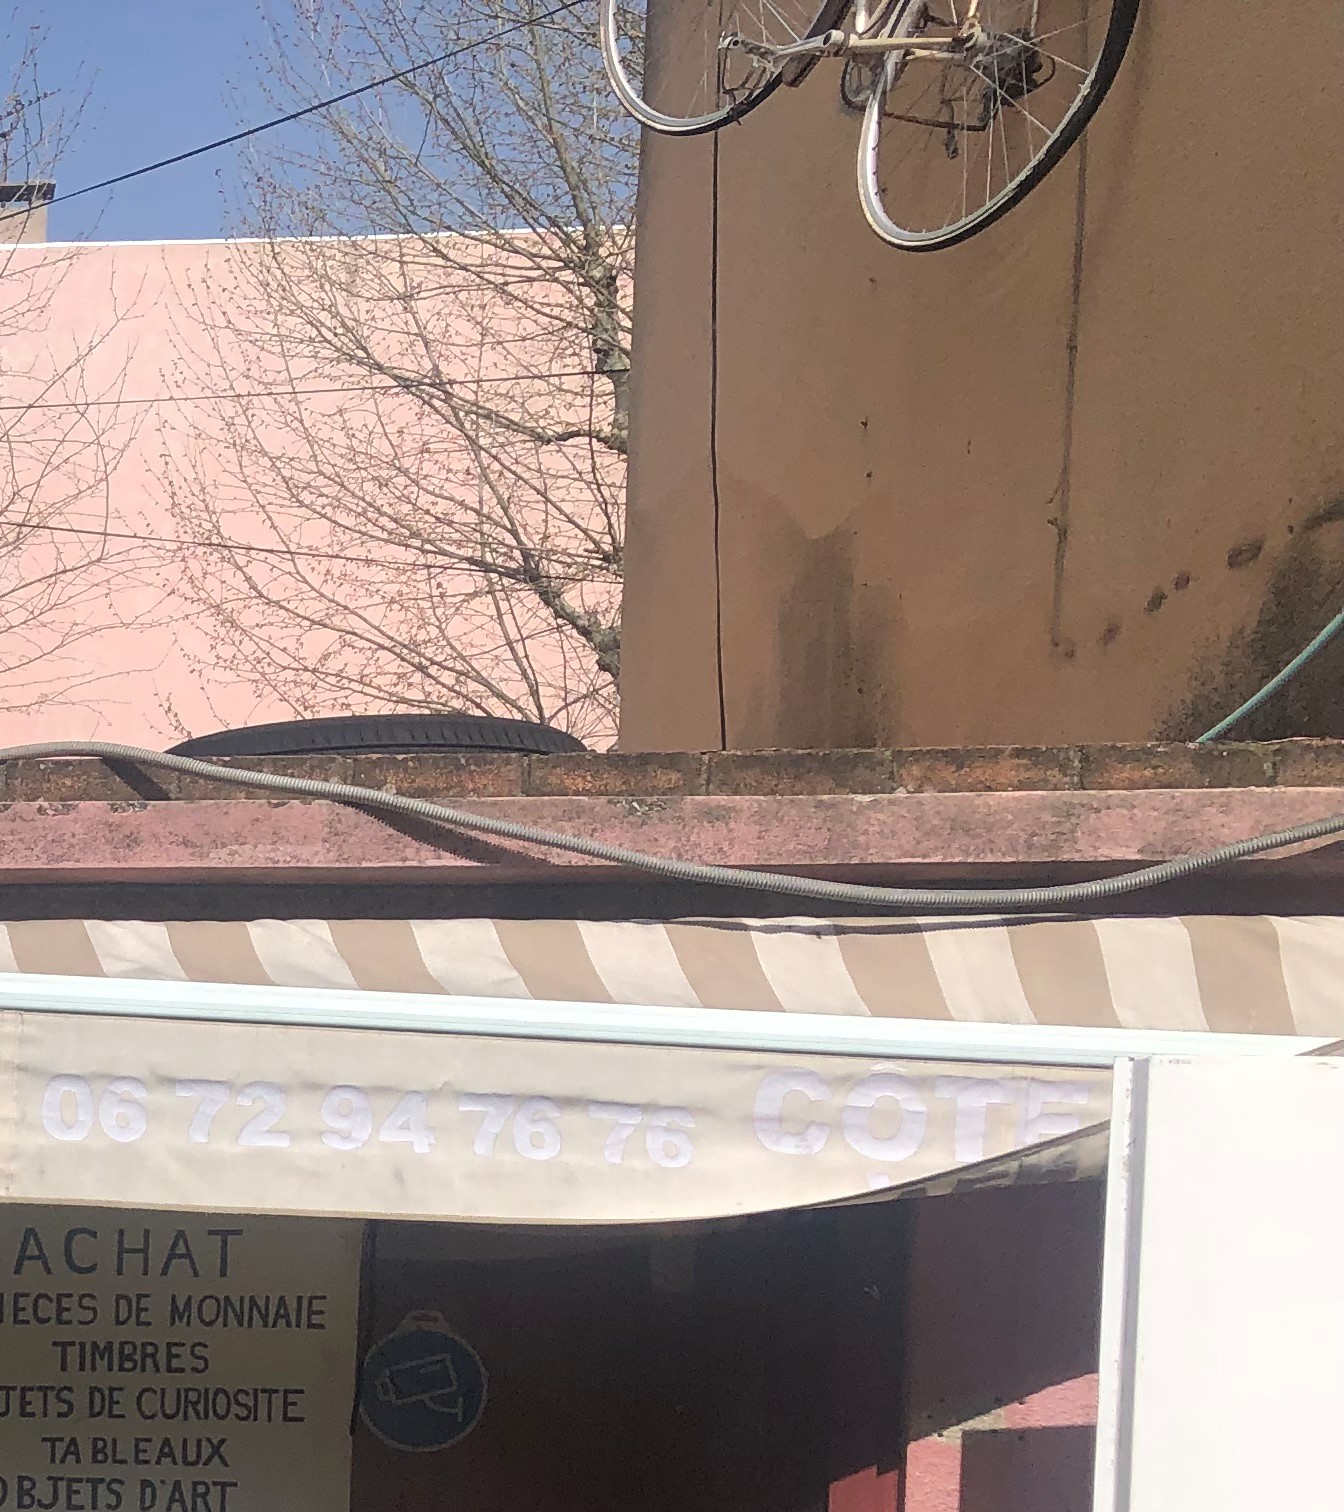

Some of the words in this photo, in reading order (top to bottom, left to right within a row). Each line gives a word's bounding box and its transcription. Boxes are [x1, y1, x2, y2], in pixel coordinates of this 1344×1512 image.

[41, 1073, 149, 1142] 06
[175, 1078, 290, 1147] 72
[320, 1084, 435, 1153] 94
[458, 1091, 561, 1160] 76
[588, 1099, 696, 1167] 76
[12, 1225, 244, 1279] ACHAT
[114, 1293, 154, 1328] DE
[170, 1294, 327, 1331] MONNAIE
[52, 1339, 211, 1375] TIMBRES
[88, 1386, 124, 1420] DE
[135, 1386, 306, 1424] CURIOSITE
[41, 1436, 230, 1468] TABLEAUX
